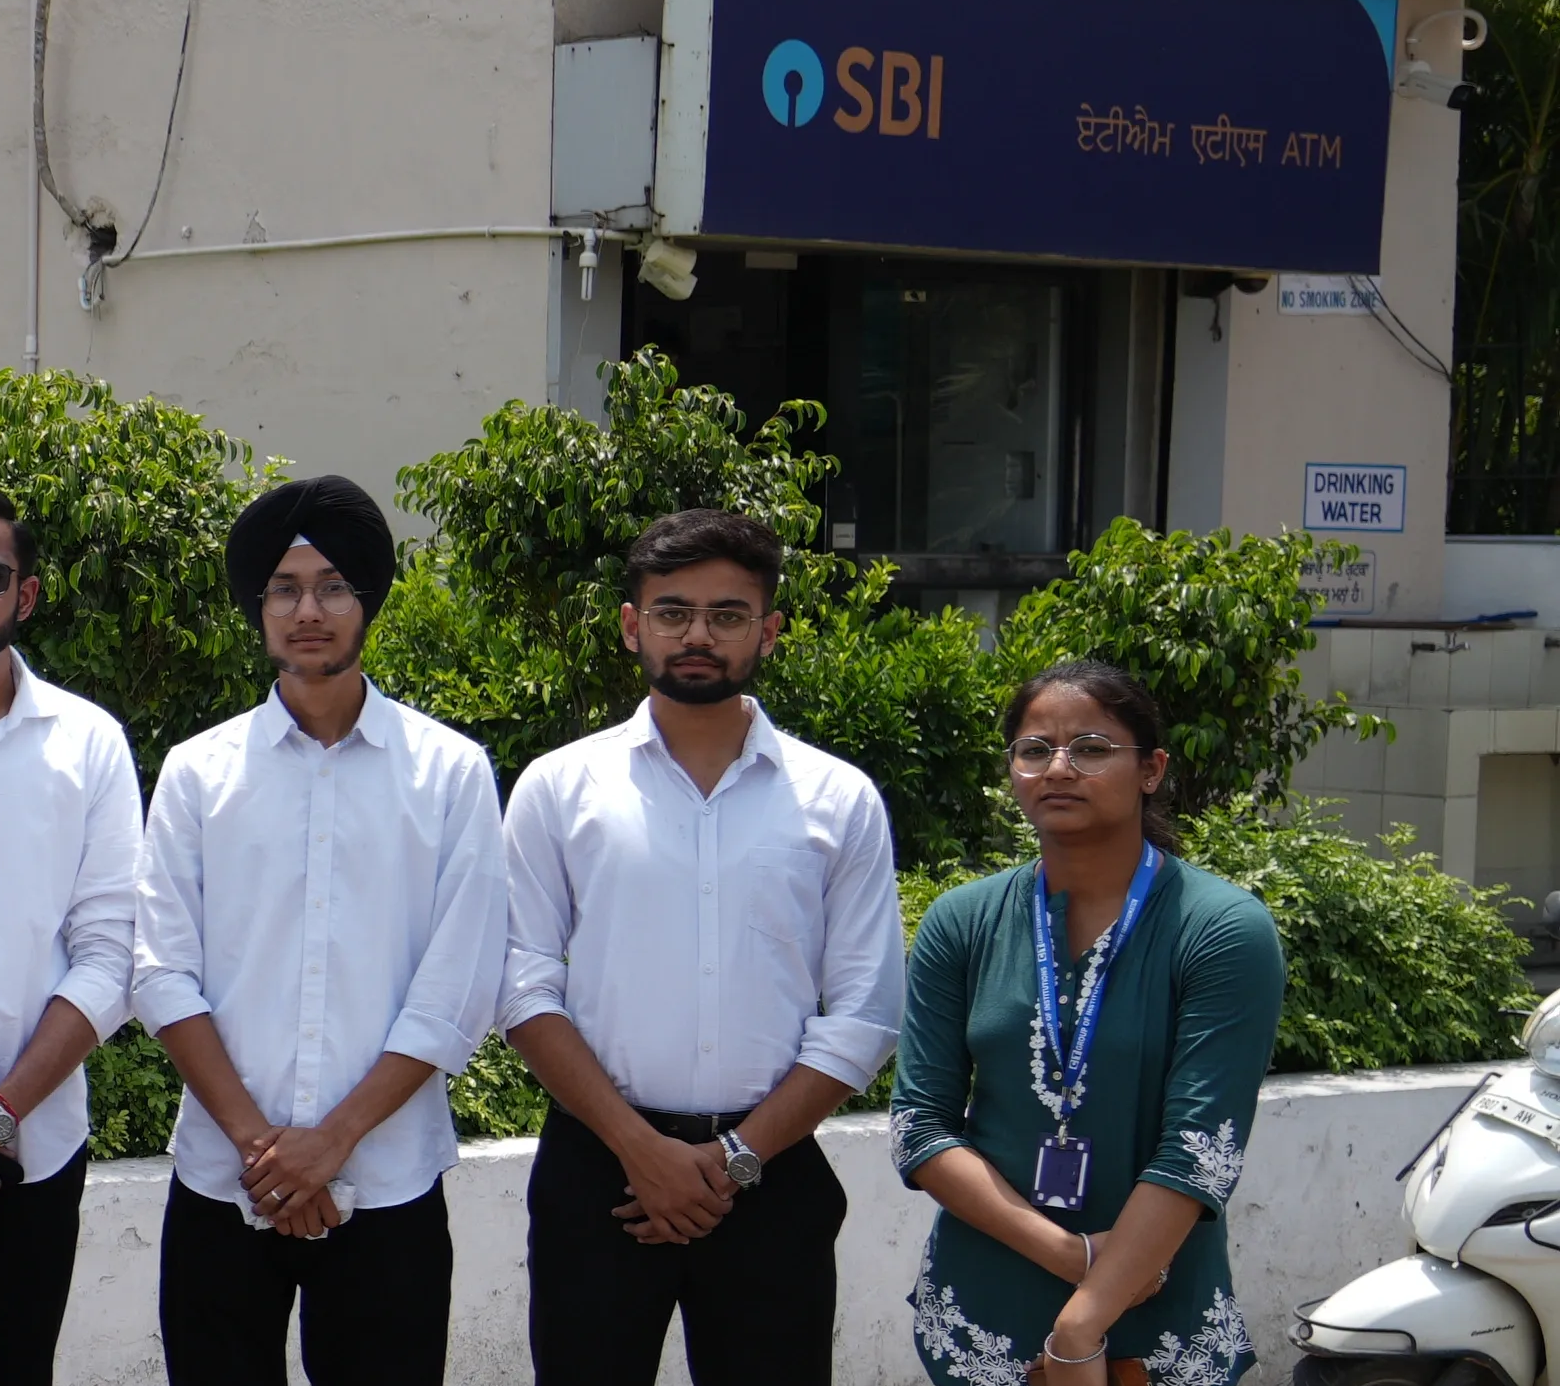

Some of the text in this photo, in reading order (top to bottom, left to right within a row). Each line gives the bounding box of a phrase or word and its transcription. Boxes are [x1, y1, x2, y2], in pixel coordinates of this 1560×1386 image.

[833, 46, 943, 139] SBI
[1191, 114, 1267, 166] एटीएम
[1281, 132, 1341, 168] ATM
[1281, 291, 1295, 309] NO
[1300, 290, 1346, 309] SMOKING
[1314, 472, 1394, 495] DRINKING
[1322, 500, 1382, 524] WATER
[1040, 966, 1051, 1011] INSTITUTIONS
[1075, 1027, 1088, 1051] GROUP
[1083, 1016, 1091, 1027] OF
[1514, 1110, 1536, 1125] AW
